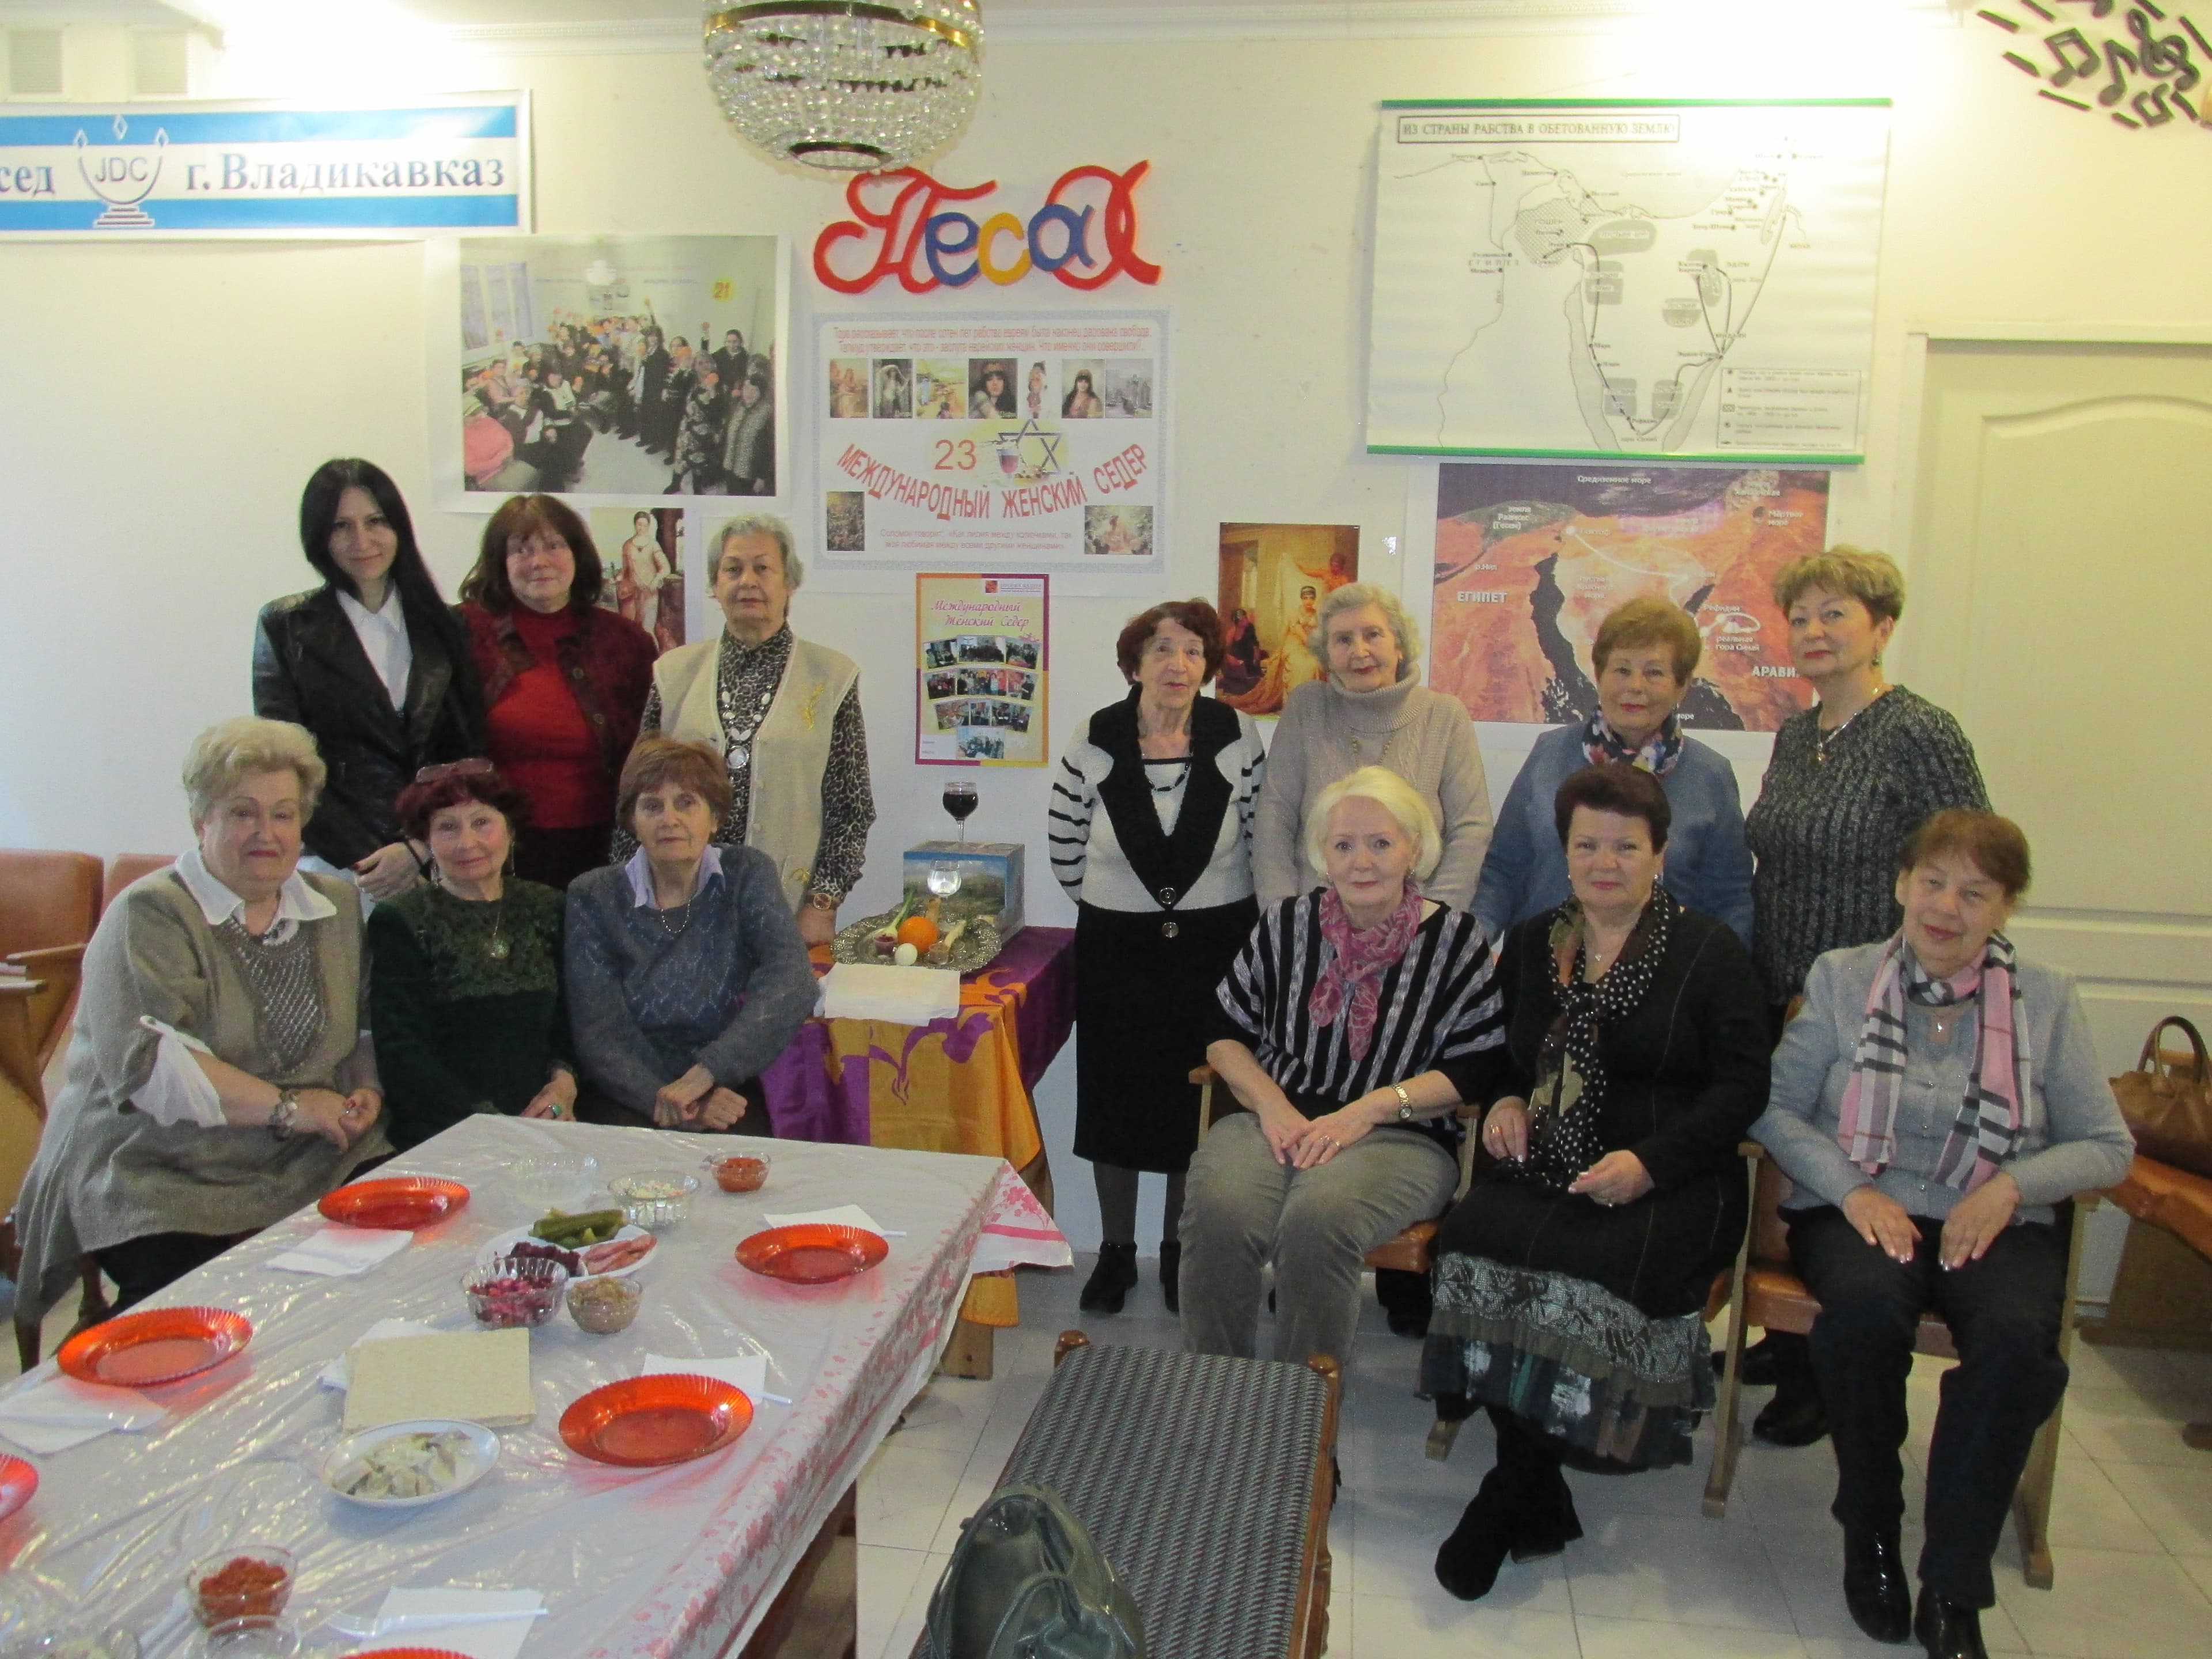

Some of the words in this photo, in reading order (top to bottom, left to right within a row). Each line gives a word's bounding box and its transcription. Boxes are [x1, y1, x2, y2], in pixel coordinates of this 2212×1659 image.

[1404, 124, 1418, 135] ИЗ
[1423, 123, 1470, 135] СТРАНЫ
[1474, 123, 1524, 134] РАБСТВА
[1527, 123, 1535, 134] В
[1539, 123, 1628, 134] ОБЕТОВАННУЮ
[96, 157, 147, 182] JDC
[187, 164, 210, 191] г.
[220, 152, 505, 194] Владикавказ
[934, 439, 977, 471] 23
[837, 443, 990, 521] МЕЖДУНАРОДНЫЙ
[1001, 471, 1088, 518] ЖЕНСКИЙ
[1093, 443, 1147, 494] СЕДЕР
[1456, 591, 1508, 603] ЕГИПЕТ
[931, 599, 1021, 616] Международный
[945, 615, 994, 627] Женский
[1001, 615, 1029, 631] Седер
[1751, 666, 1800, 678] АРАВИ
